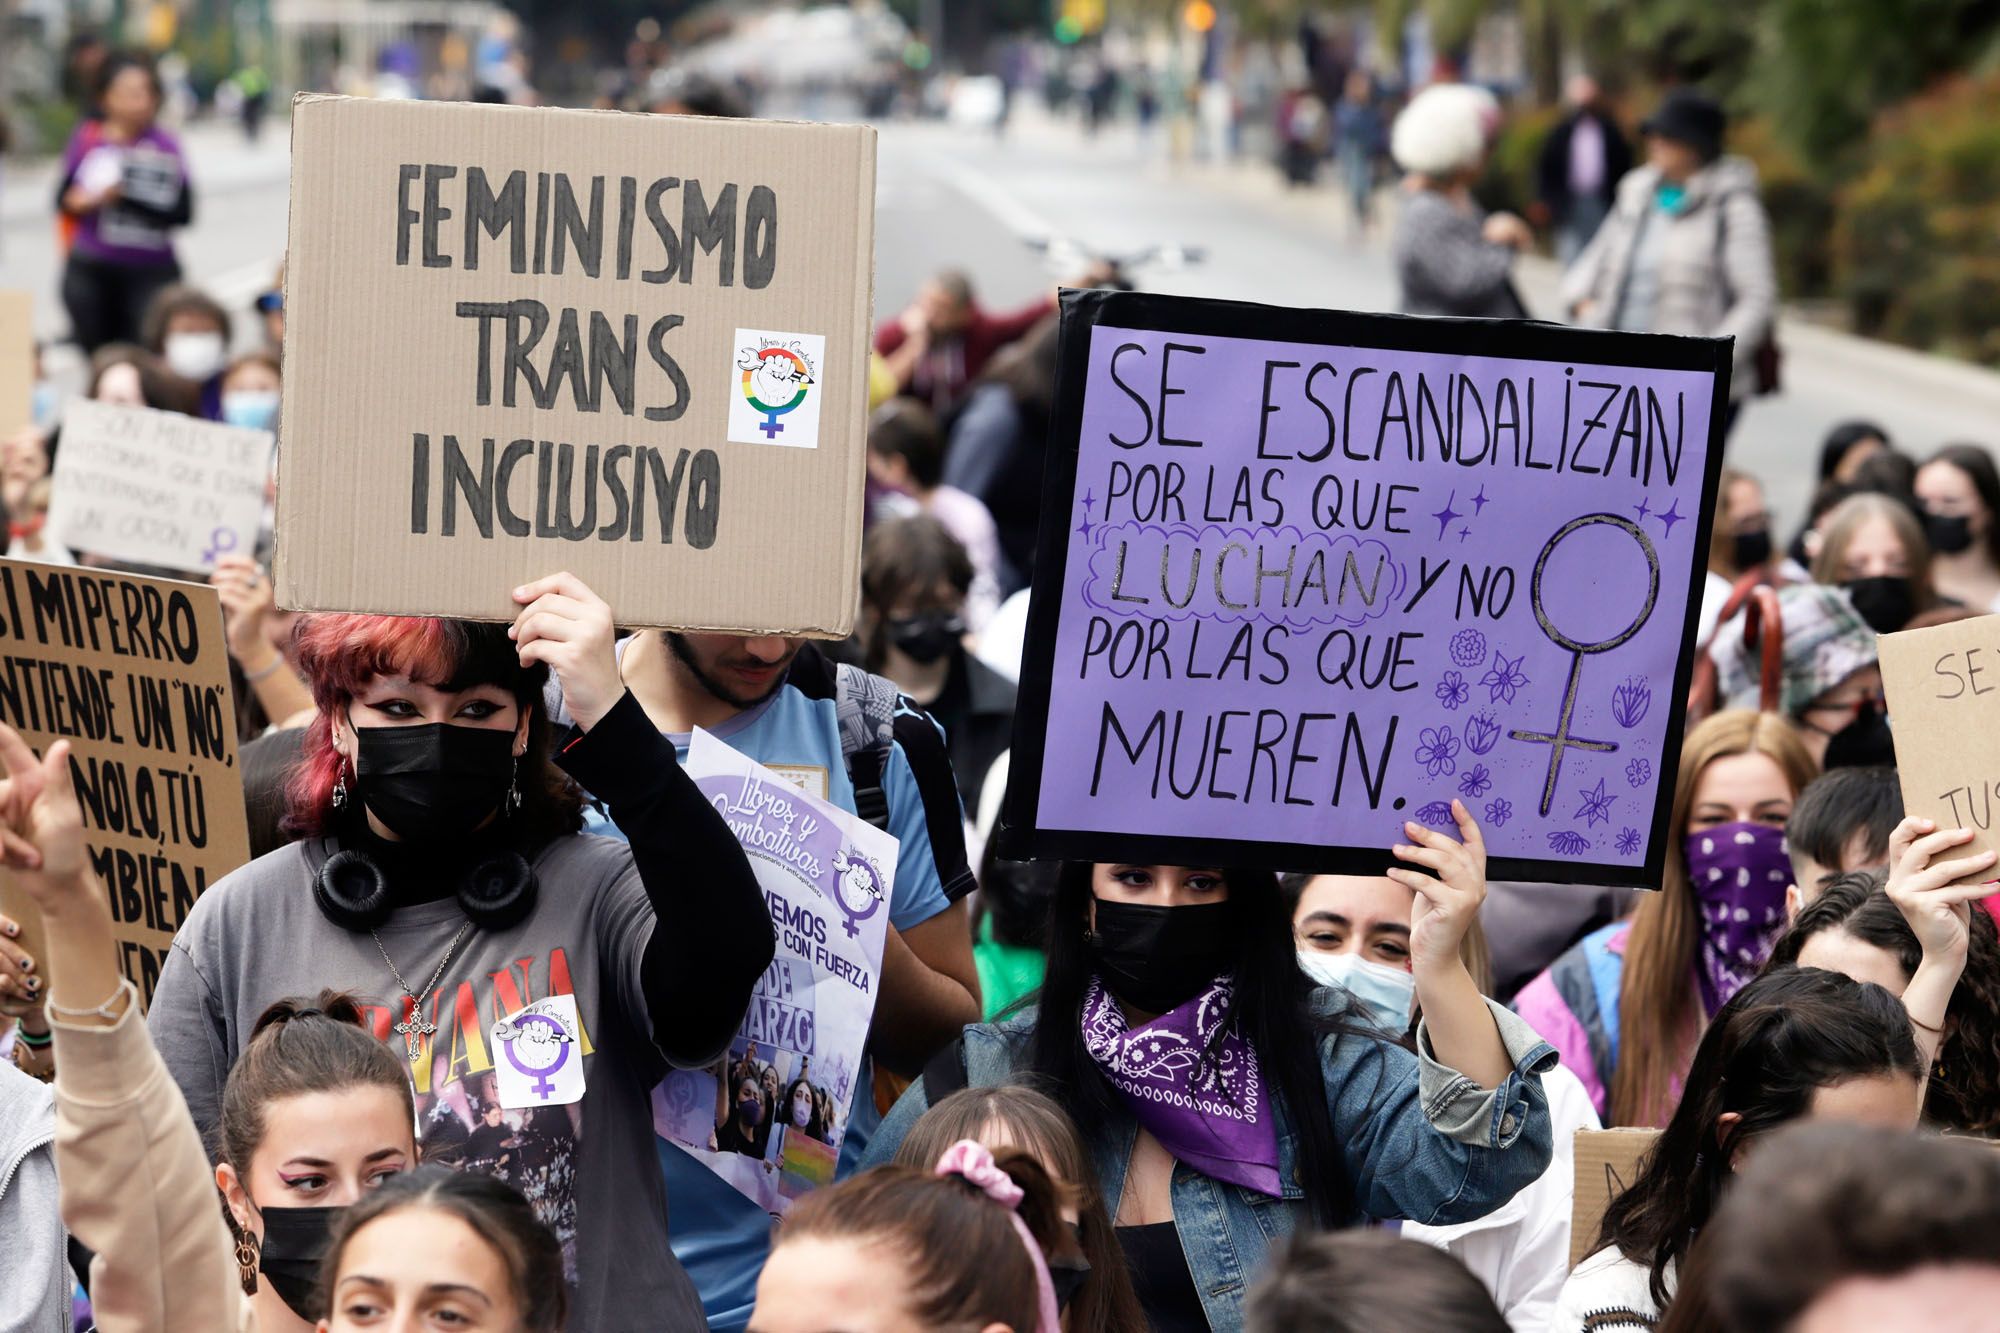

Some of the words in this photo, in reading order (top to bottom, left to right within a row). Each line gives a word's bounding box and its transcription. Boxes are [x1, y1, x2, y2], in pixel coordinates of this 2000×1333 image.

[396, 163, 777, 290] FEMINISMO
[456, 299, 691, 422] TRANS
[1109, 342, 1206, 450] SE
[411, 432, 721, 550] INCLUSIVO
[1104, 460, 1187, 524] POR
[1203, 464, 1286, 528] LAS
[1310, 474, 1420, 534] QUE
[1109, 539, 1385, 611] LUCHAN
[1403, 556, 1450, 615] Y
[1456, 563, 1515, 621] NO
[1079, 615, 1184, 682] POR
[1186, 618, 1290, 685] LAS
[1316, 629, 1424, 692] QUE
[1935, 648, 2000, 699] SE
[127, 674, 177, 753] UN
[1089, 700, 1406, 811] MUEREN.
[68, 753, 165, 846] NOLO,
[158, 764, 208, 849] TÚ
[728, 763, 798, 824] Libres
[799, 814, 818, 842] y
[87, 843, 207, 933] MBIÉN
[786, 867, 822, 898] anticapitalista
[784, 930, 811, 960] CON
[816, 946, 869, 994] FUERZA
